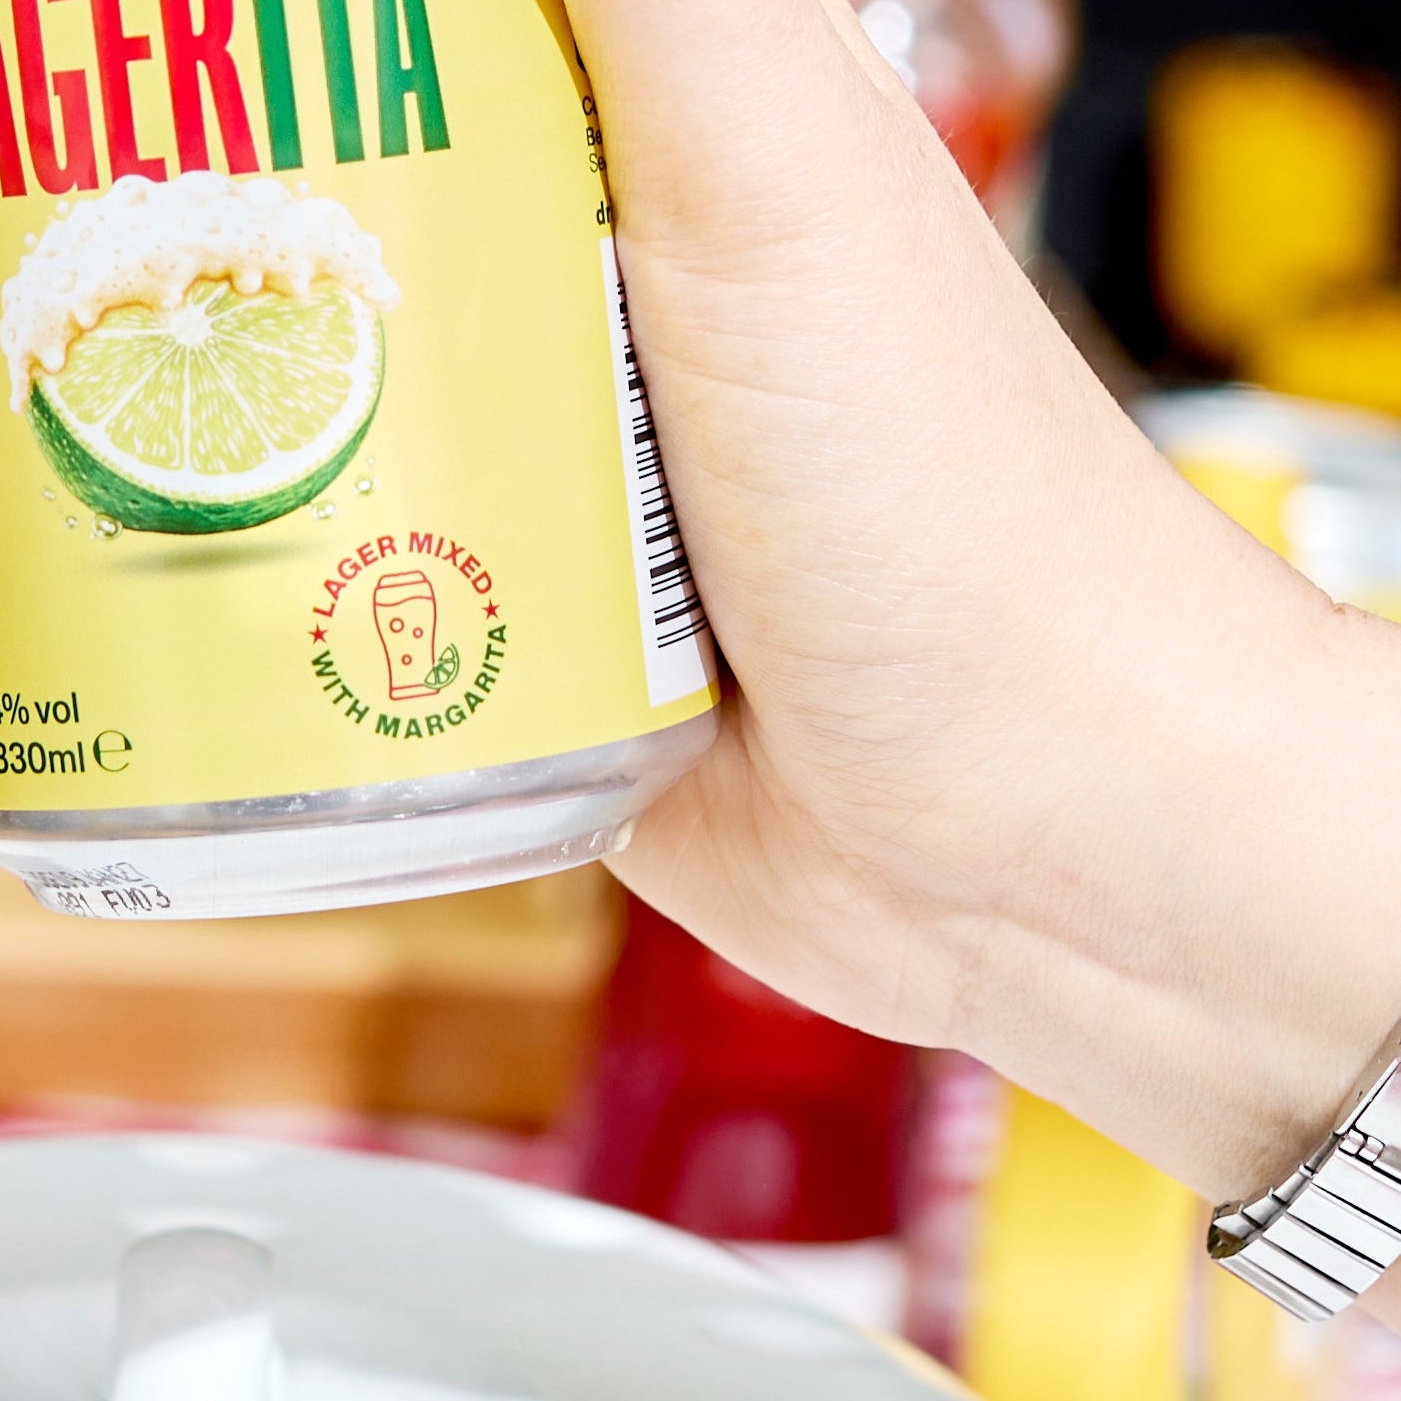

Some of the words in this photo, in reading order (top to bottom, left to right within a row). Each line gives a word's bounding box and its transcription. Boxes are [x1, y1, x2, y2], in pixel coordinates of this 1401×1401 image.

[312, 535, 398, 618] LAGER
[408, 531, 492, 595] MIXED
[34, 691, 80, 725] vol
[311, 650, 370, 724] WITH
[375, 624, 507, 739] MARGARITA
